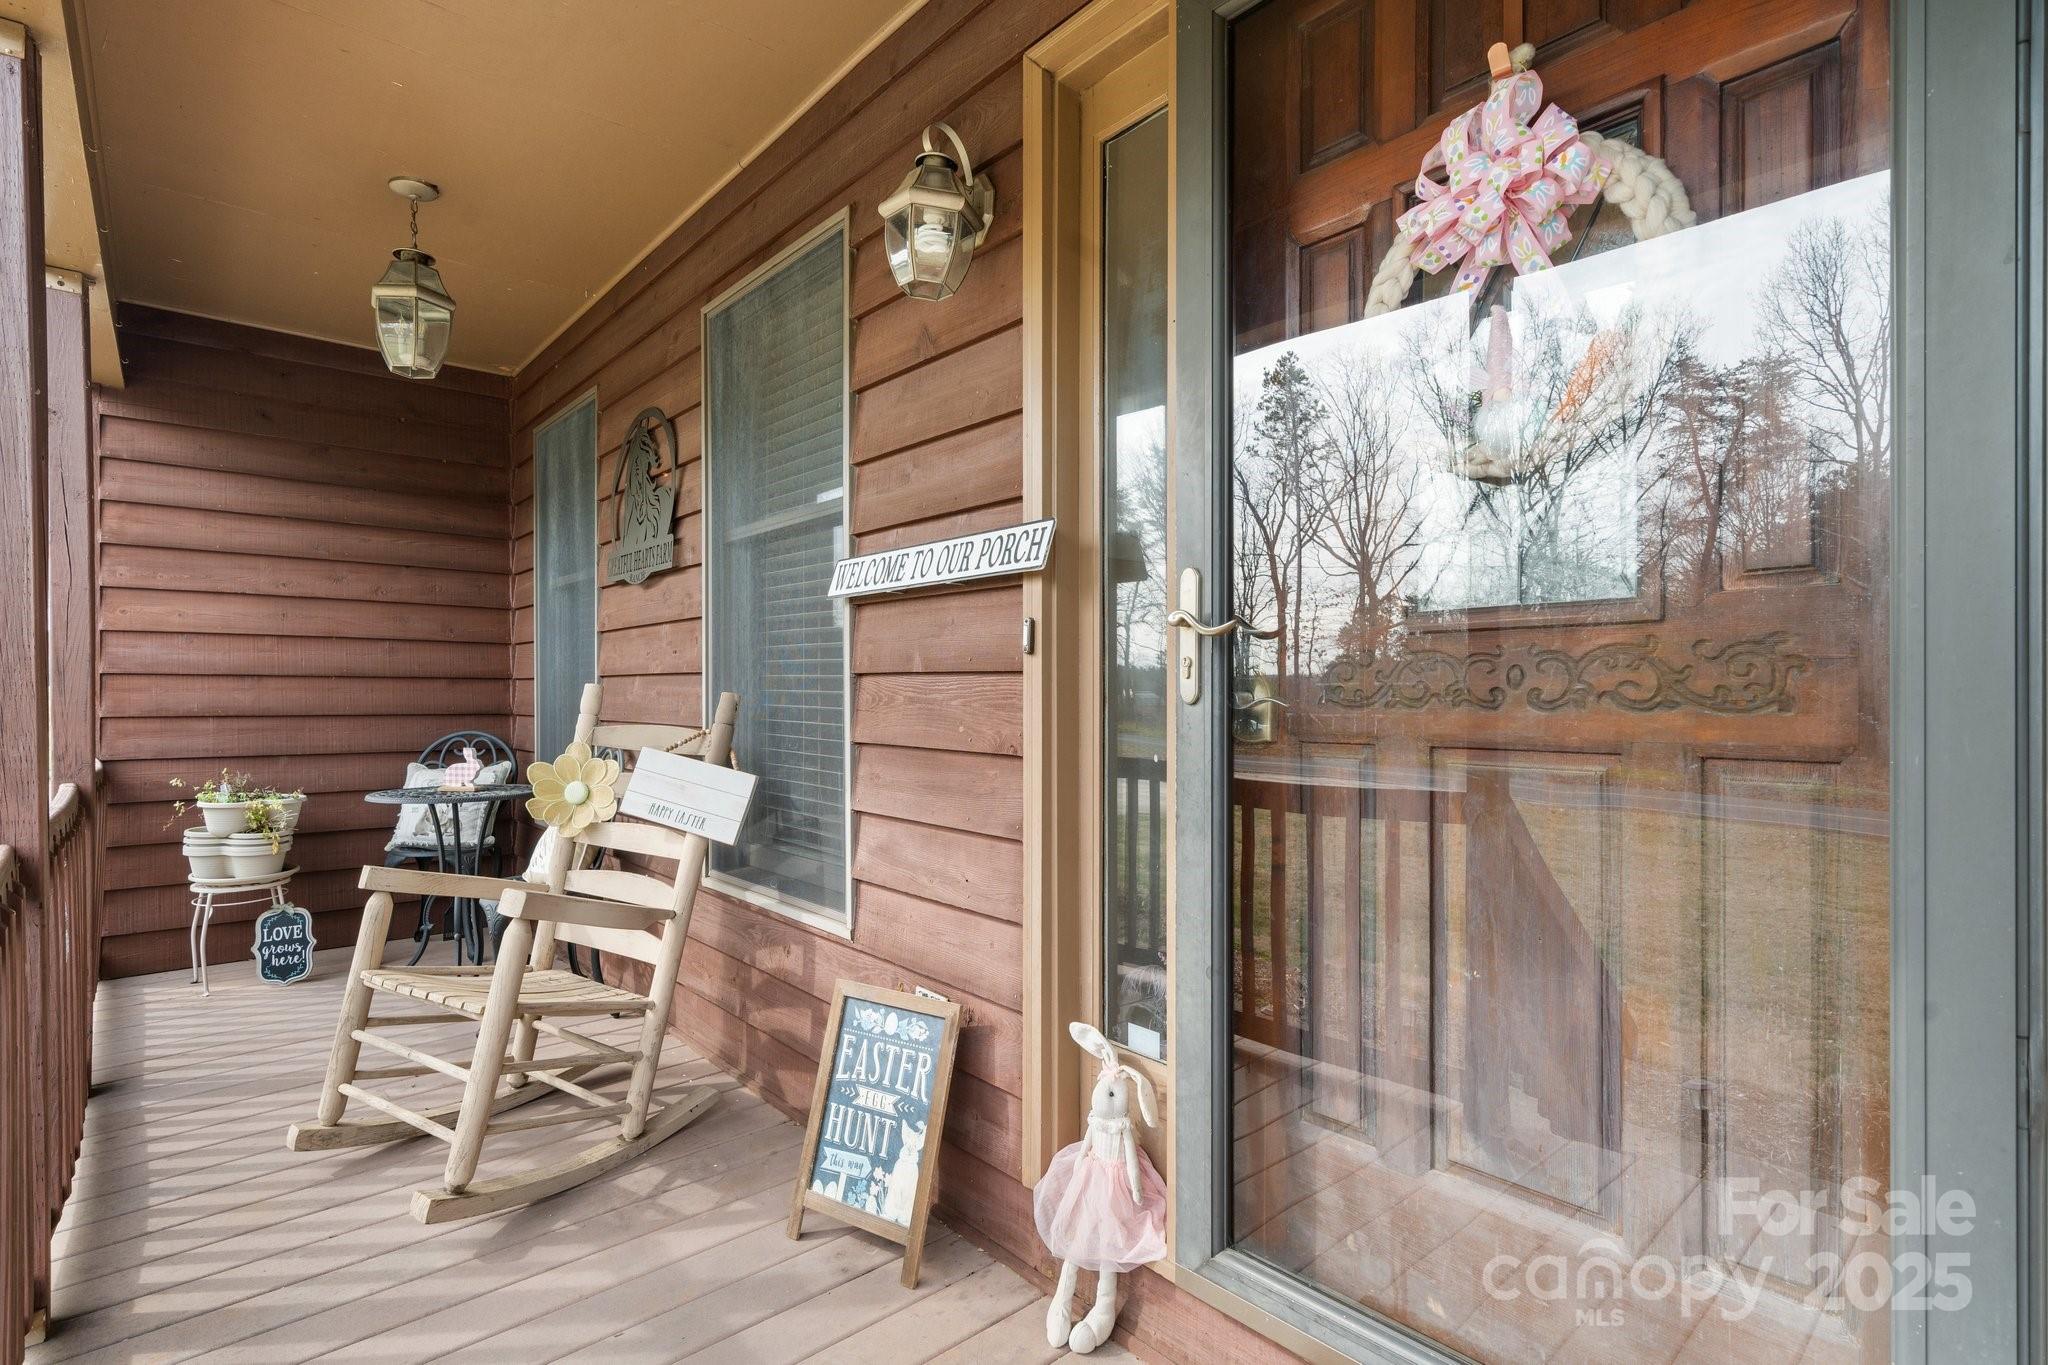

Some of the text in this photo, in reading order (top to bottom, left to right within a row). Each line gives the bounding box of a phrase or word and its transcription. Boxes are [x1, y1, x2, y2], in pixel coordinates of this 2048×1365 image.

[834, 526, 1048, 591] WELCOME TO OUR PORCH
[648, 802, 673, 820] HAPPY
[262, 924, 303, 942] LOVE
[262, 942, 304, 960] grows
[272, 949, 305, 966] here!
[835, 1033, 933, 1106] EASTER
[863, 1090, 889, 1110] EGG
[824, 1102, 898, 1161] HUNT
[829, 1153, 864, 1172] this way
